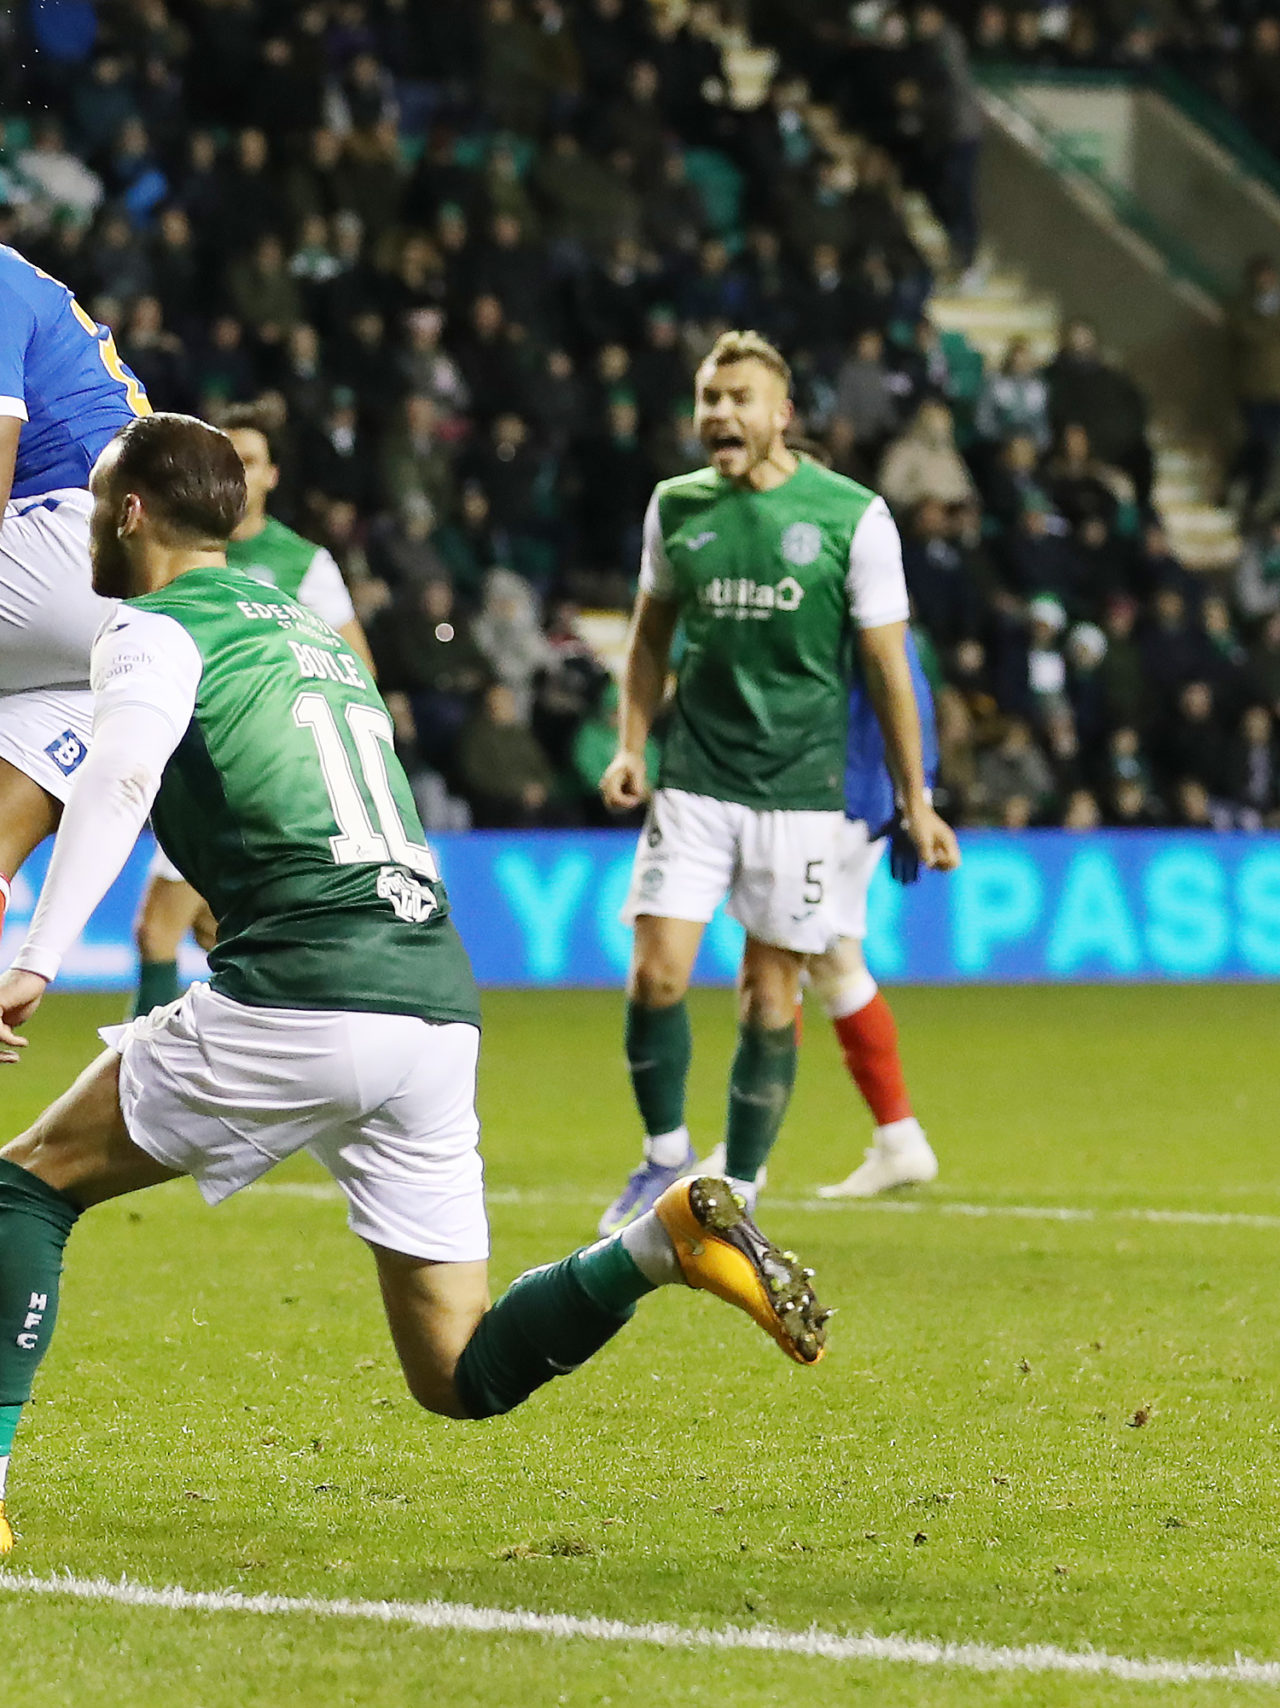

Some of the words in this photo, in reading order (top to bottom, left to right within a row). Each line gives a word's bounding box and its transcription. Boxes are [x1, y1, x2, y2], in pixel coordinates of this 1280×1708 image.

[236, 601, 304, 619] EDEN
[287, 640, 367, 691] BOYLE
[803, 859, 824, 905] 5
[16, 1292, 47, 1350] HFC
